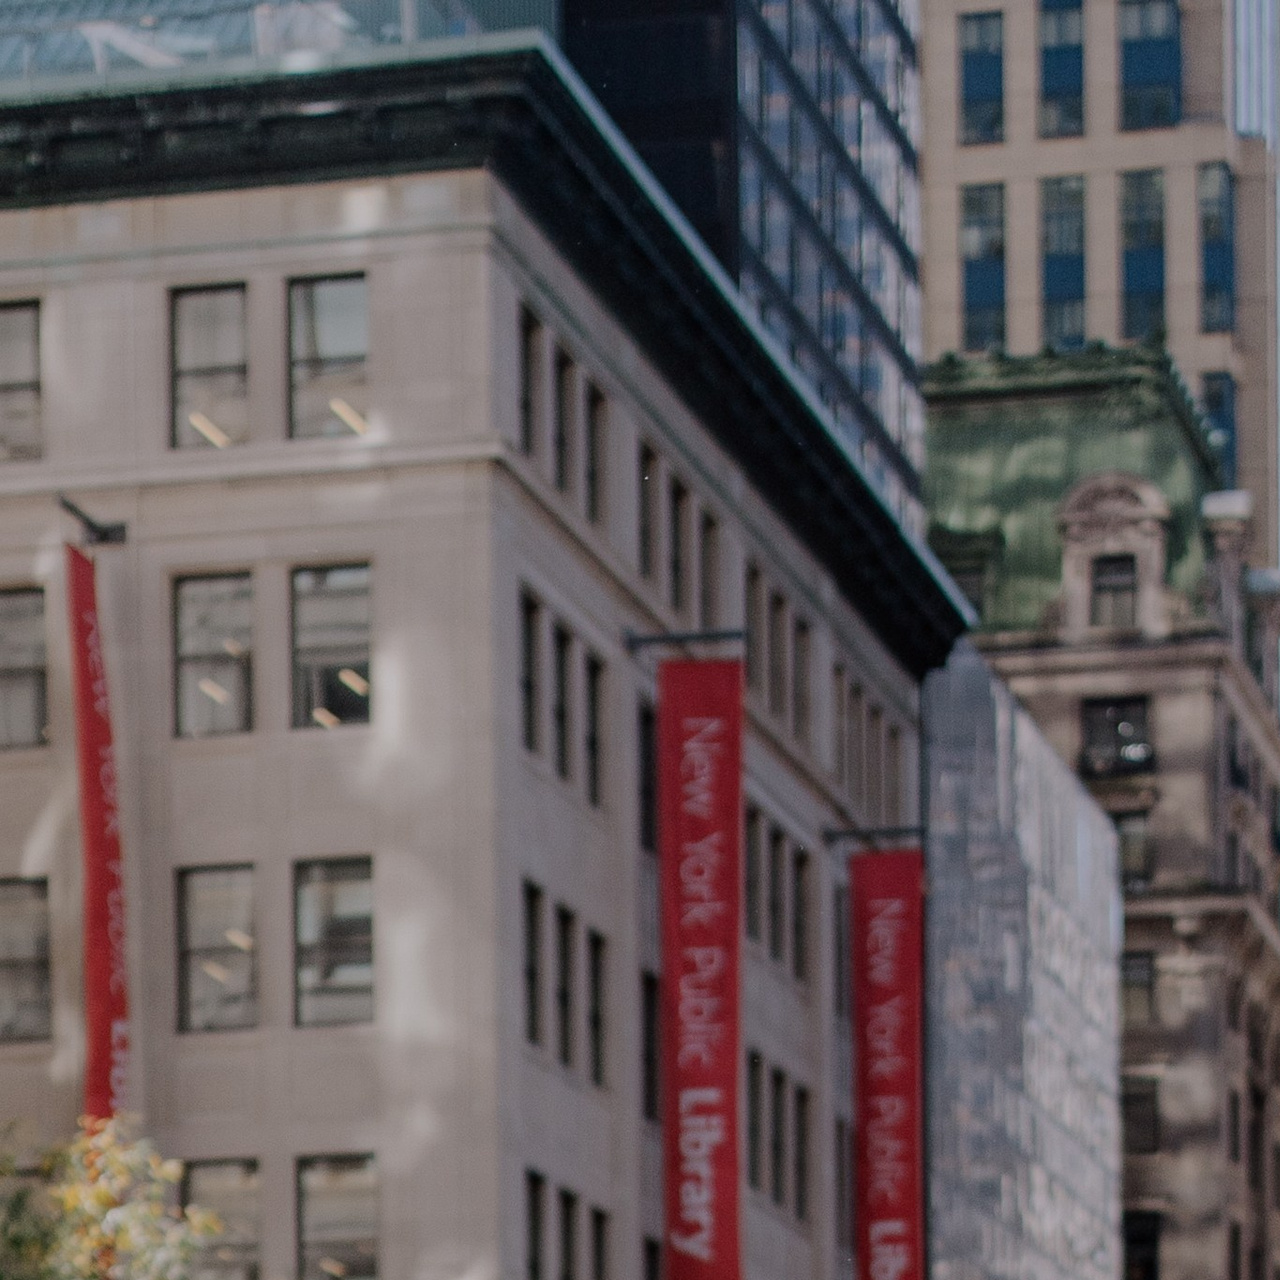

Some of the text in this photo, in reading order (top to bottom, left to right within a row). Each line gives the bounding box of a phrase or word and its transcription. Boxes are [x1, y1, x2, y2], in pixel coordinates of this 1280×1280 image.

[669, 717, 726, 1263] New York Public Library
[867, 899, 905, 985] New
[866, 994, 906, 1080] York
[866, 1094, 906, 1203] Public
